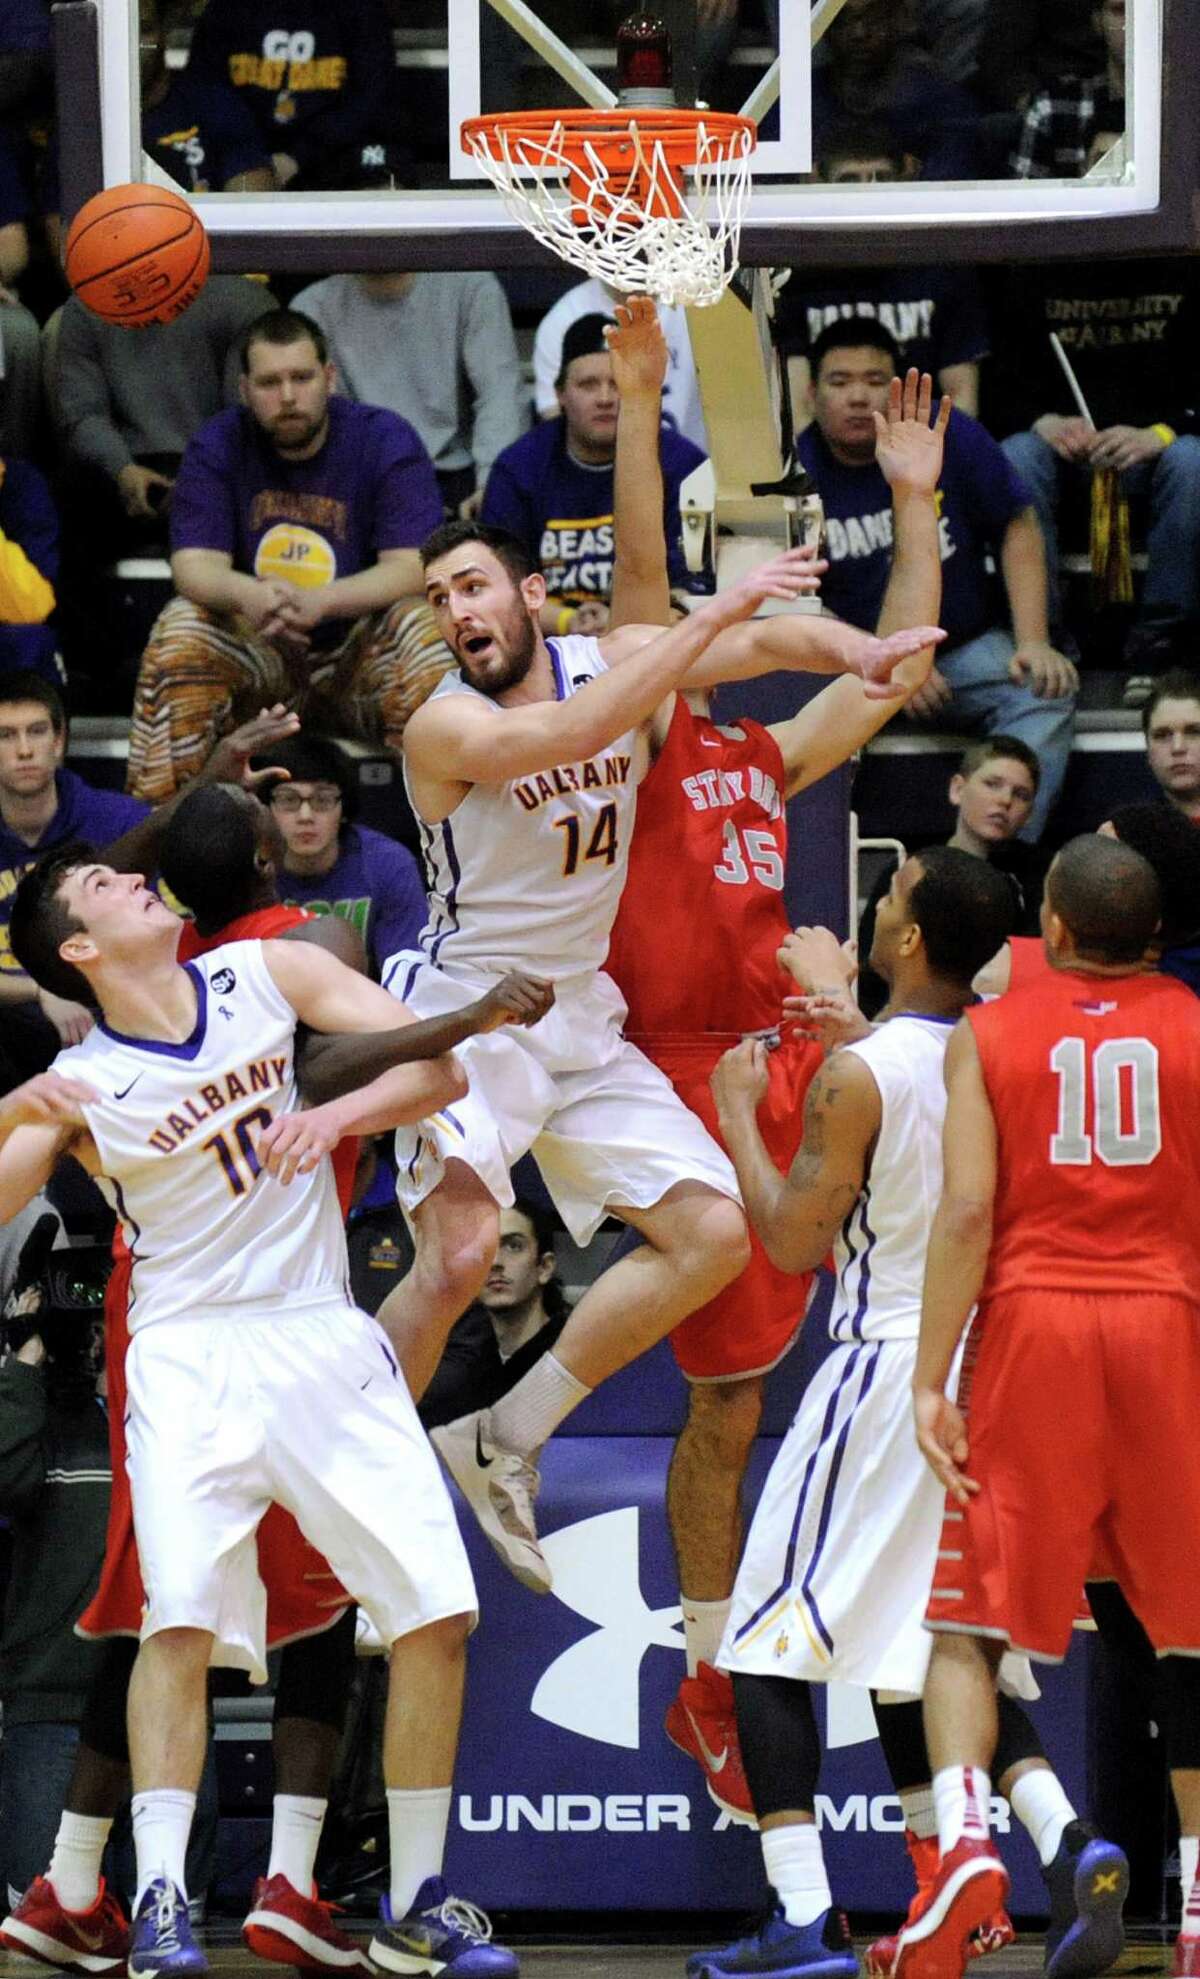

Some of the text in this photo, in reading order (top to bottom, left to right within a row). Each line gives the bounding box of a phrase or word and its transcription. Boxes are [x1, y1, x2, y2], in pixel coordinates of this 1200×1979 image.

[263, 30, 315, 63] GO
[281, 541, 311, 560] JP
[540, 525, 614, 561] BEAS
[681, 768, 746, 811] STY
[552, 800, 619, 879] 14
[714, 818, 785, 891] 35
[148, 1057, 287, 1155] UALBANY
[1050, 1036, 1162, 1167] 10
[459, 1795, 1011, 1833] UNDER AMOR
